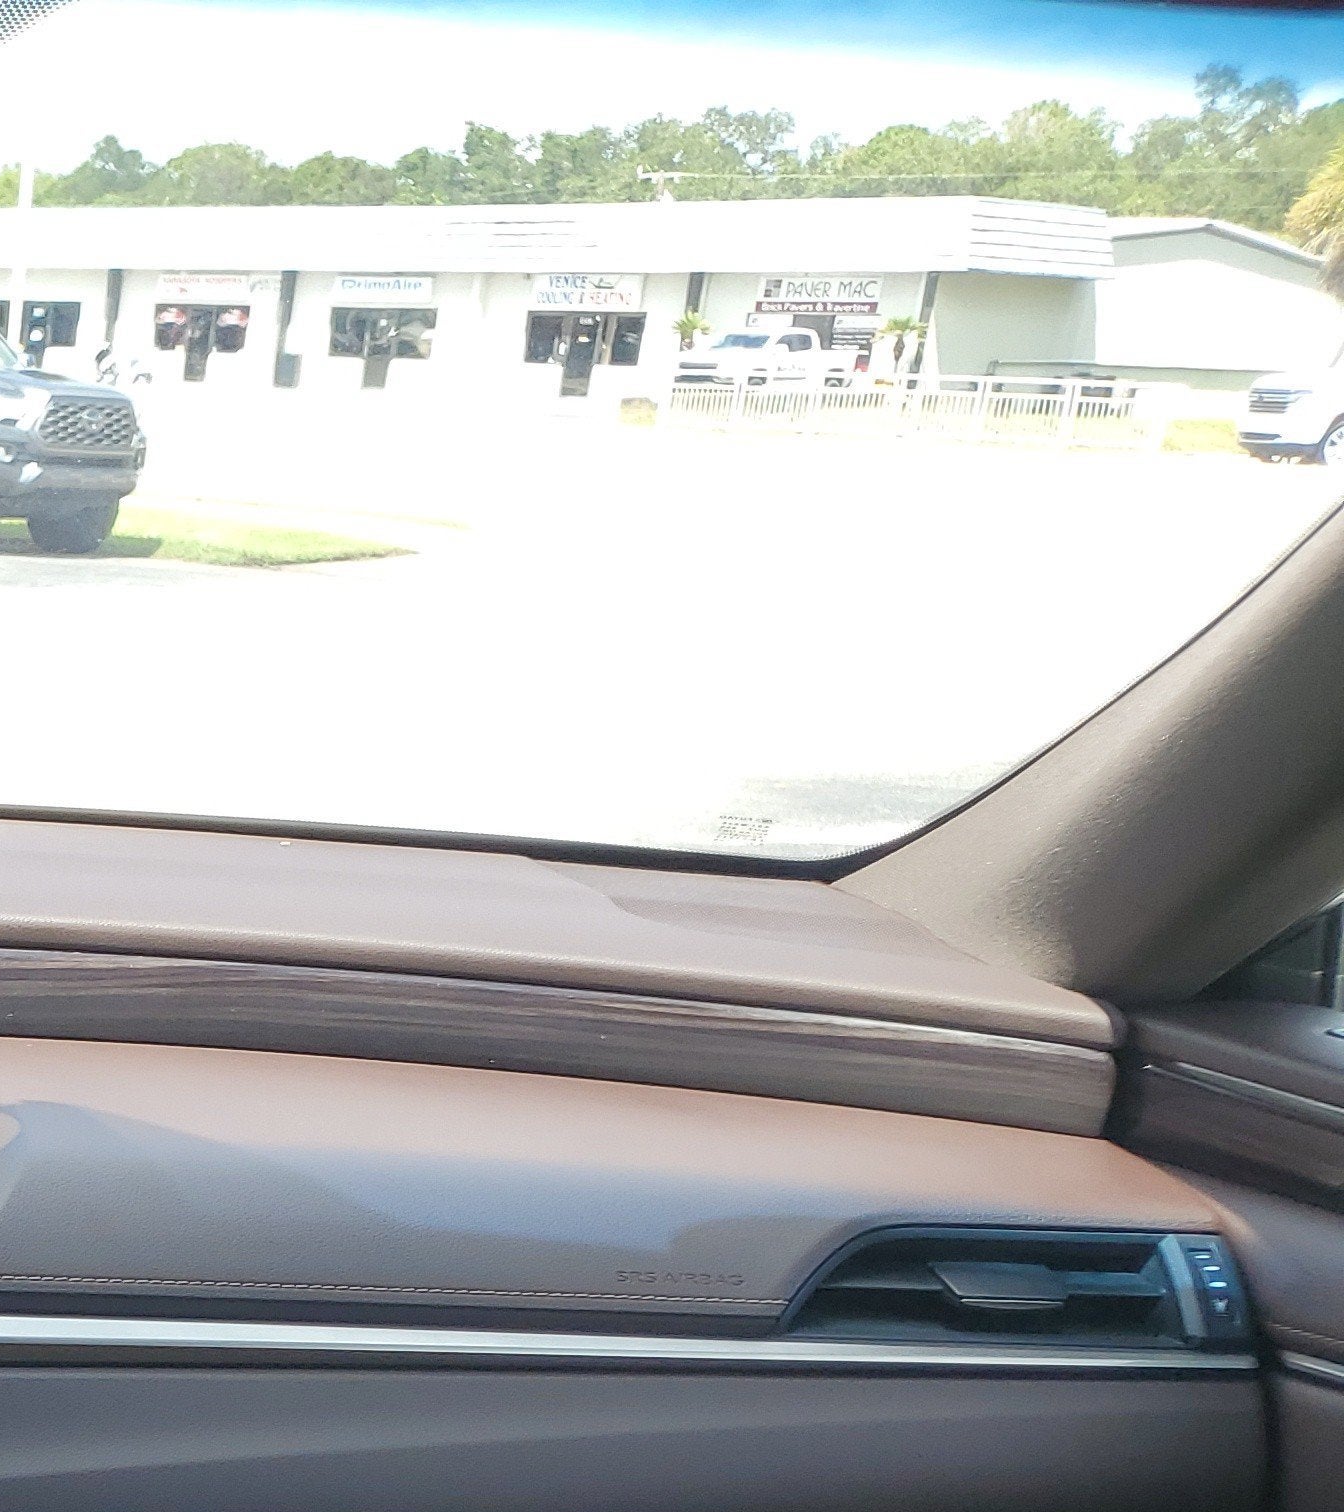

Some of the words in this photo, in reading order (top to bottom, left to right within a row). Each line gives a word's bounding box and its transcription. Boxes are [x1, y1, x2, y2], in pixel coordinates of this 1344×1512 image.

[549, 275, 588, 289] VENICE
[785, 281, 832, 298] PAVER
[837, 280, 878, 298] MAC
[615, 1270, 657, 1283] SRS
